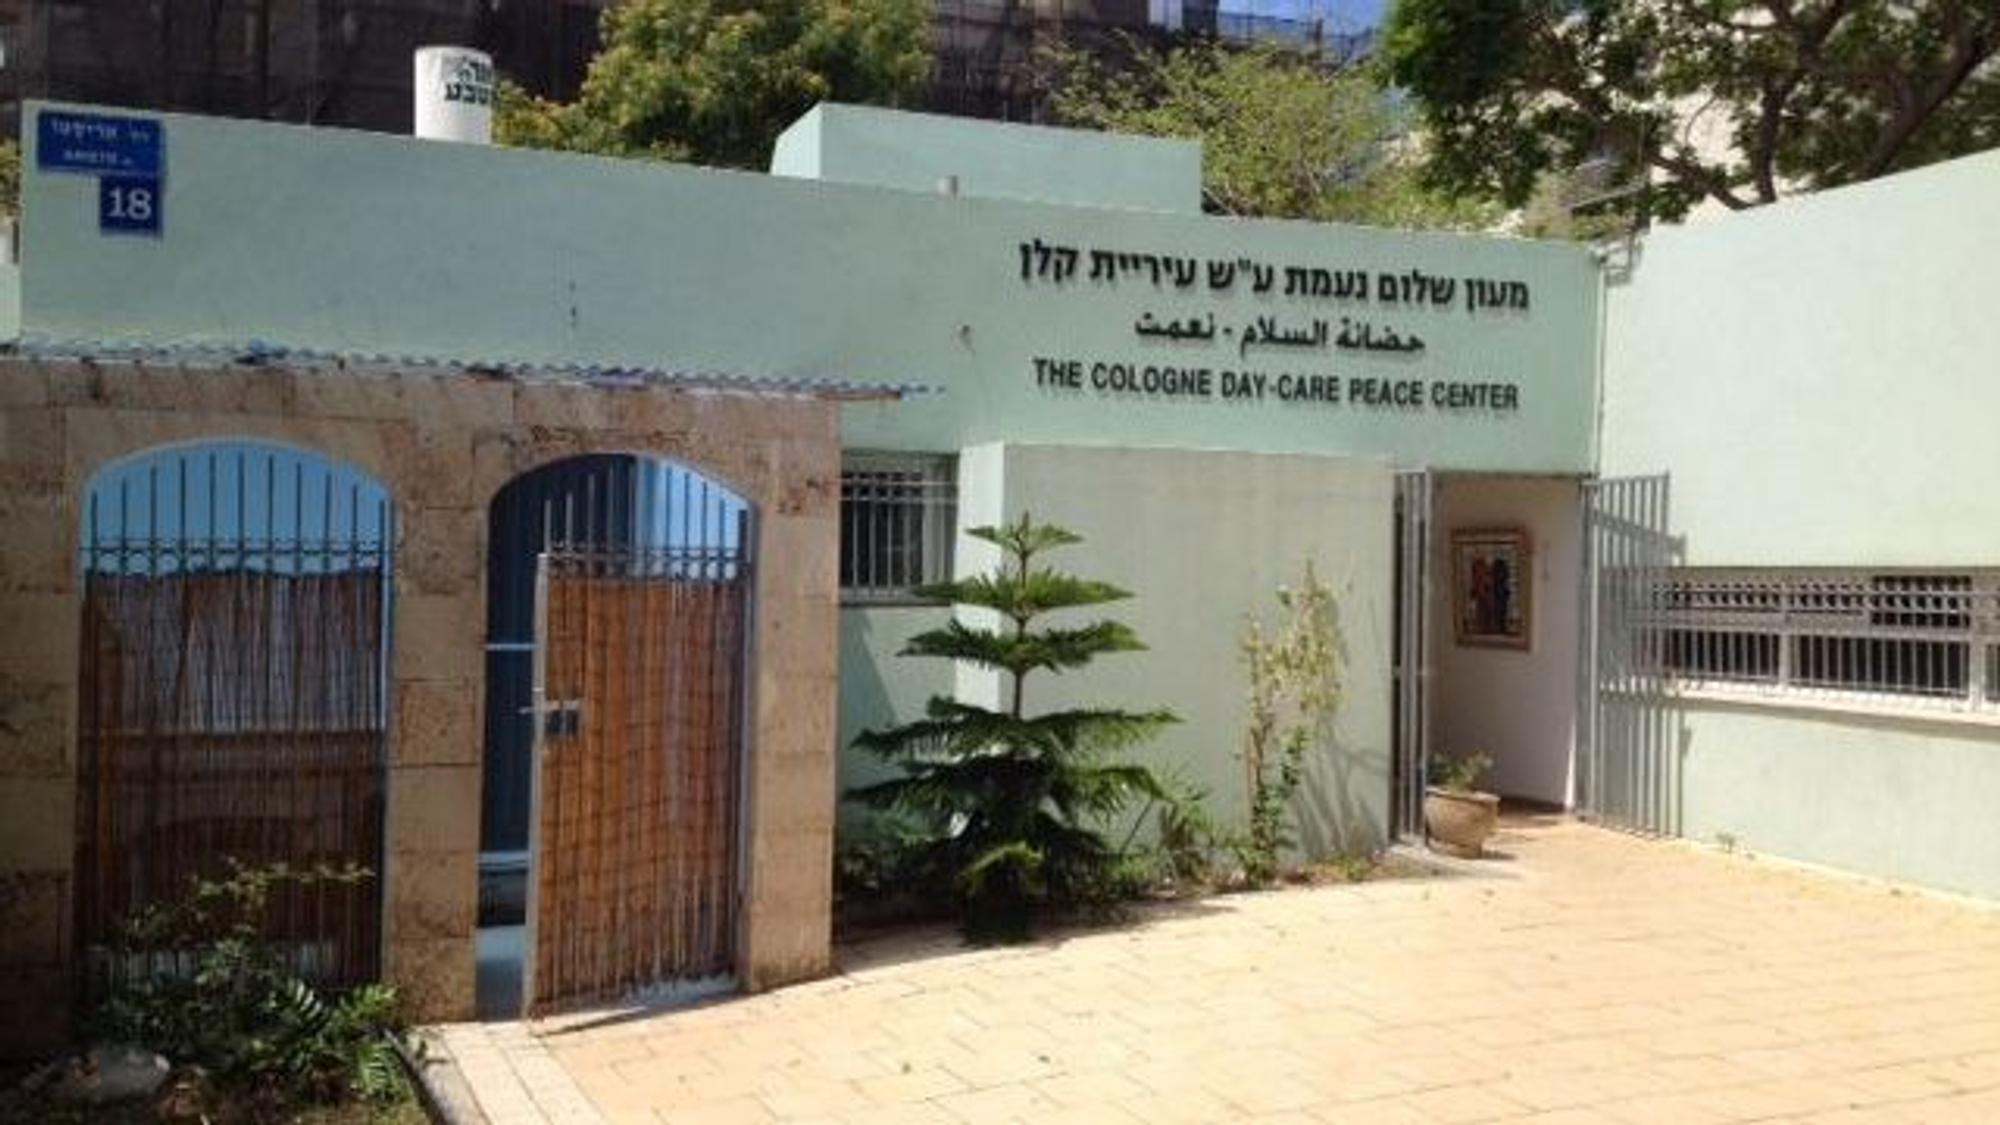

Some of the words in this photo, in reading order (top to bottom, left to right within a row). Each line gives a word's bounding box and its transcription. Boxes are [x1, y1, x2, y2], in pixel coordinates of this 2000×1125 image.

[107, 187, 151, 220] 18
[1018, 238, 1079, 282] קלן
[1089, 249, 1197, 288] עיריית
[1284, 266, 1368, 300] נעמת
[1377, 268, 1456, 306] שלום
[1465, 277, 1530, 313] מעון
[1134, 311, 1215, 340] نعمت
[1240, 313, 1328, 356] السلام
[1335, 316, 1425, 351] حضانة
[1034, 358, 1083, 388] THE
[1091, 361, 1212, 396] COLOGNE
[1221, 371, 1340, 402] DAY-CARE
[1349, 378, 1424, 405] PEACE
[1431, 382, 1519, 409] CENTER
